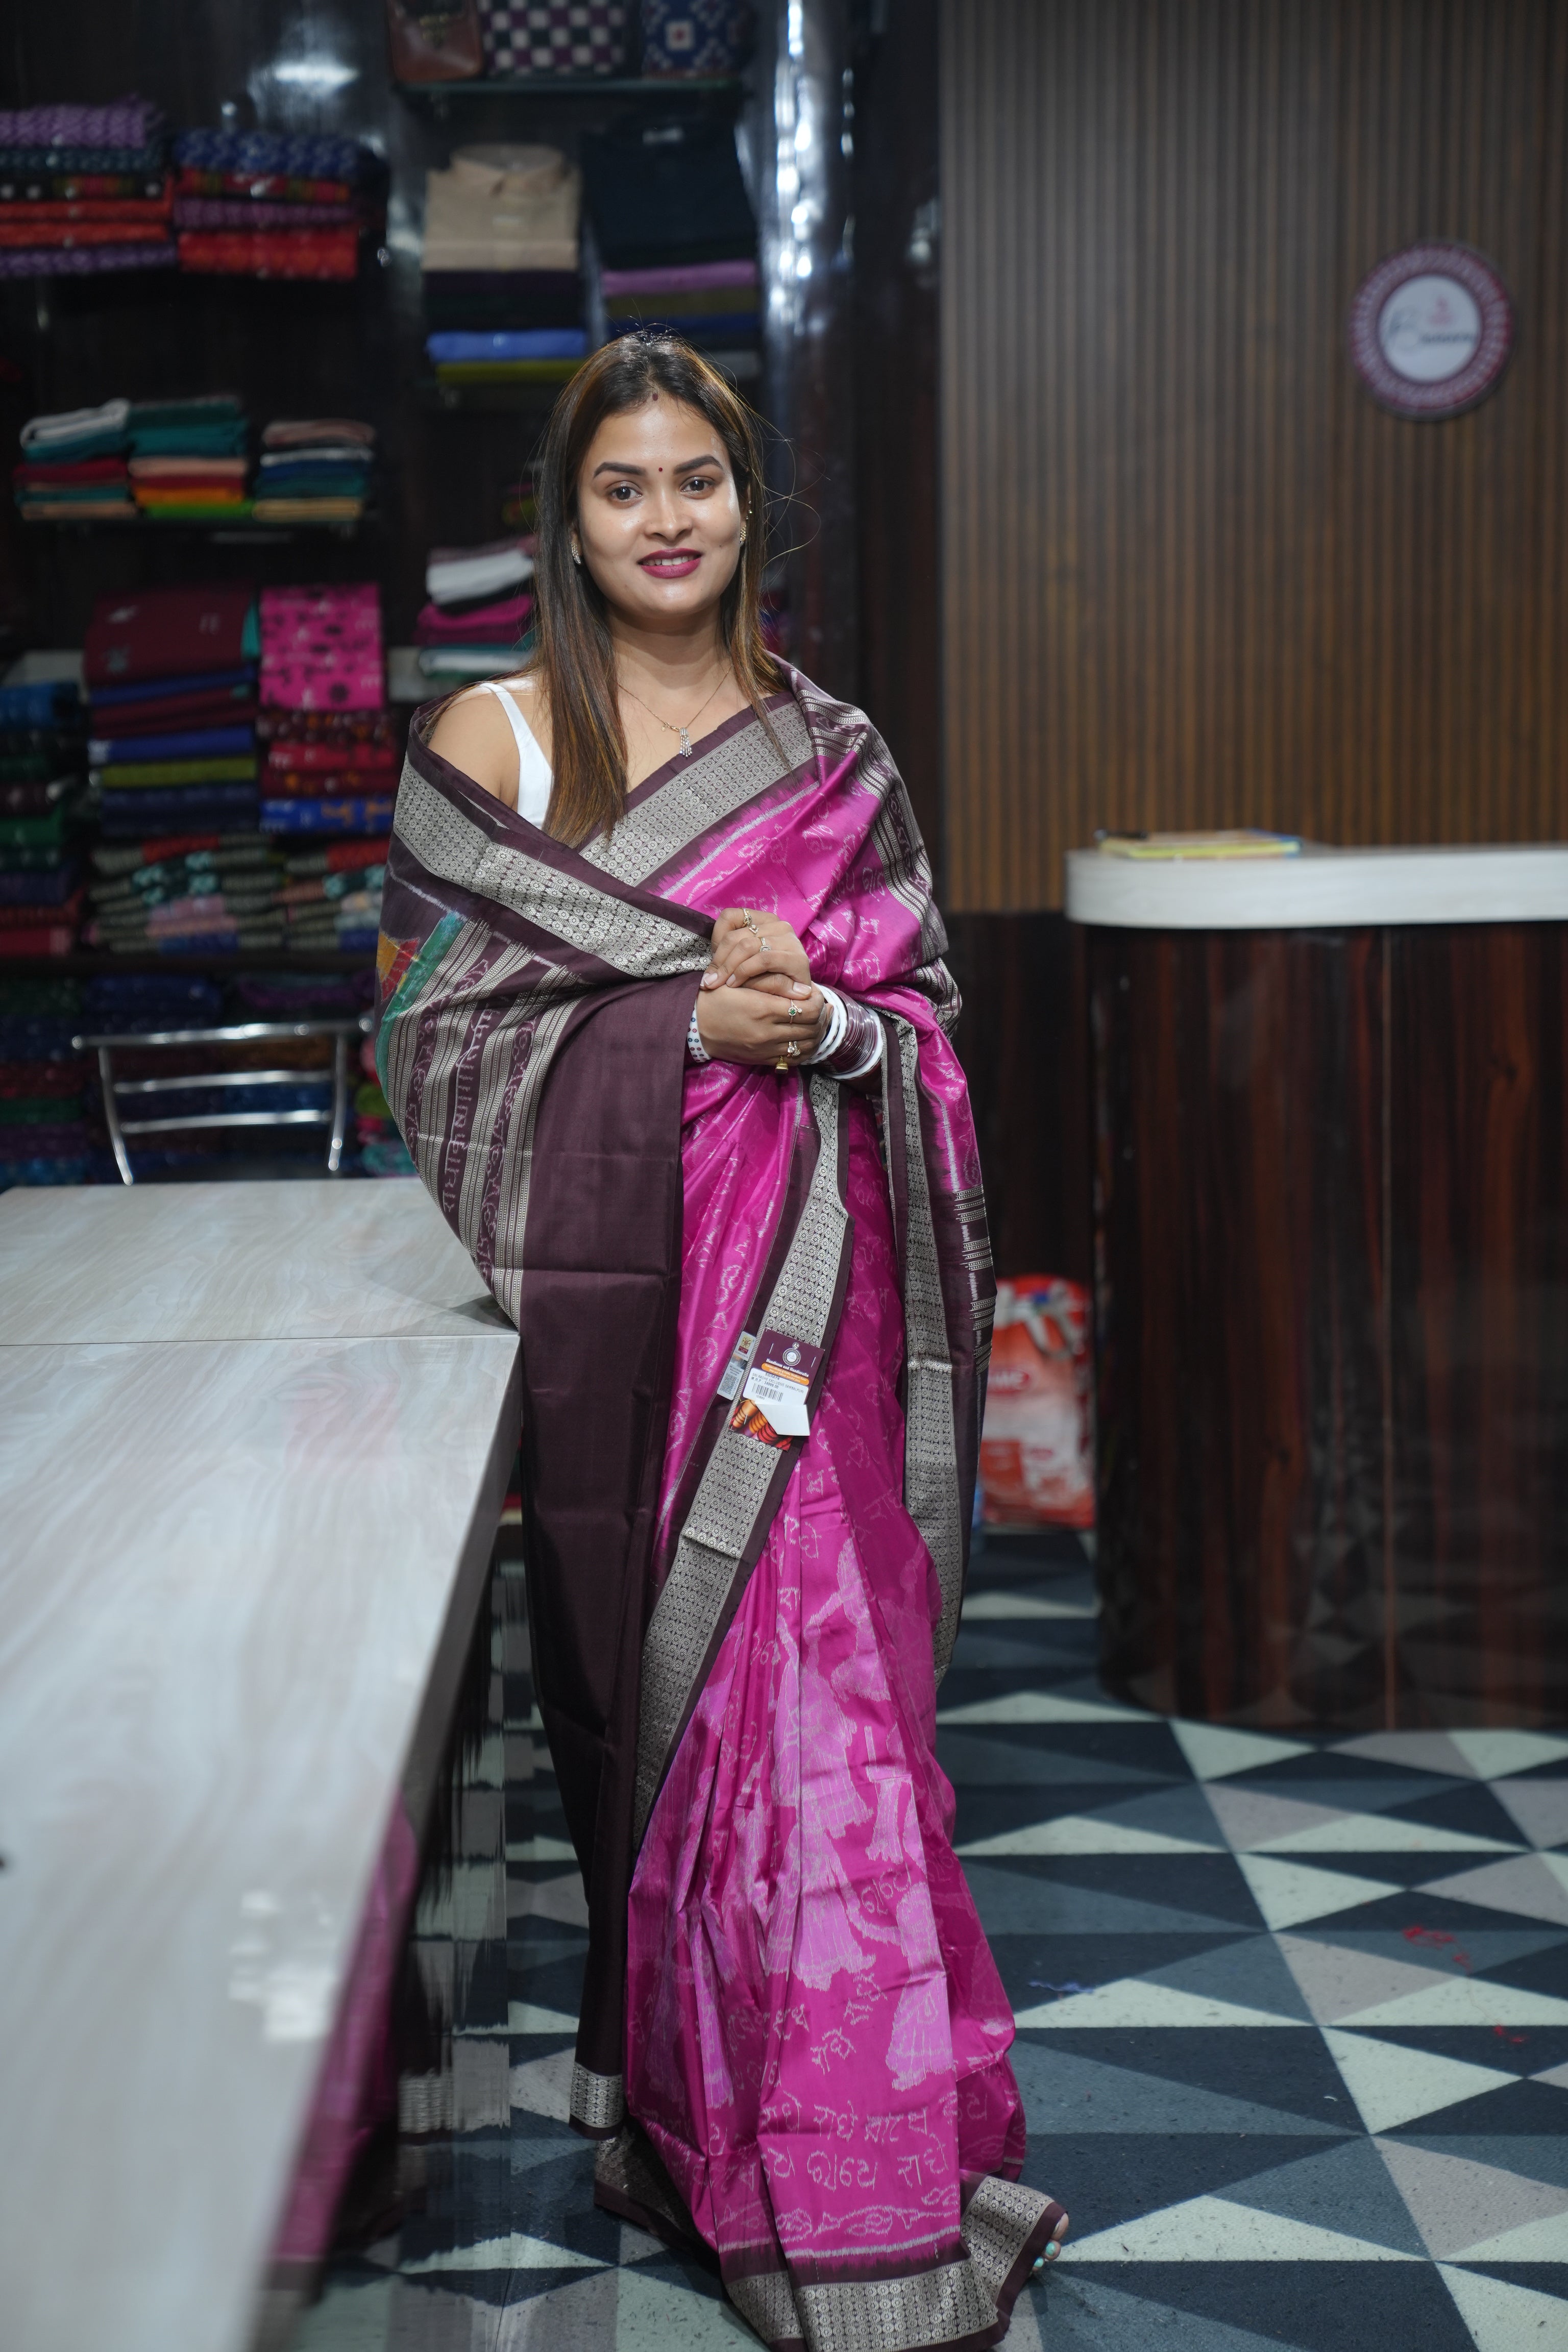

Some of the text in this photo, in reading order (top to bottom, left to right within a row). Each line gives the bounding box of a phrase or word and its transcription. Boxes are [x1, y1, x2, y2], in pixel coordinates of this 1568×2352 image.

[766, 1358, 782, 1367] Handloom
[790, 1366, 809, 1378] Handicrafts
[768, 1377, 784, 1387] EXCLUSIVE
[785, 1384, 804, 1393] SAMBALPURI
